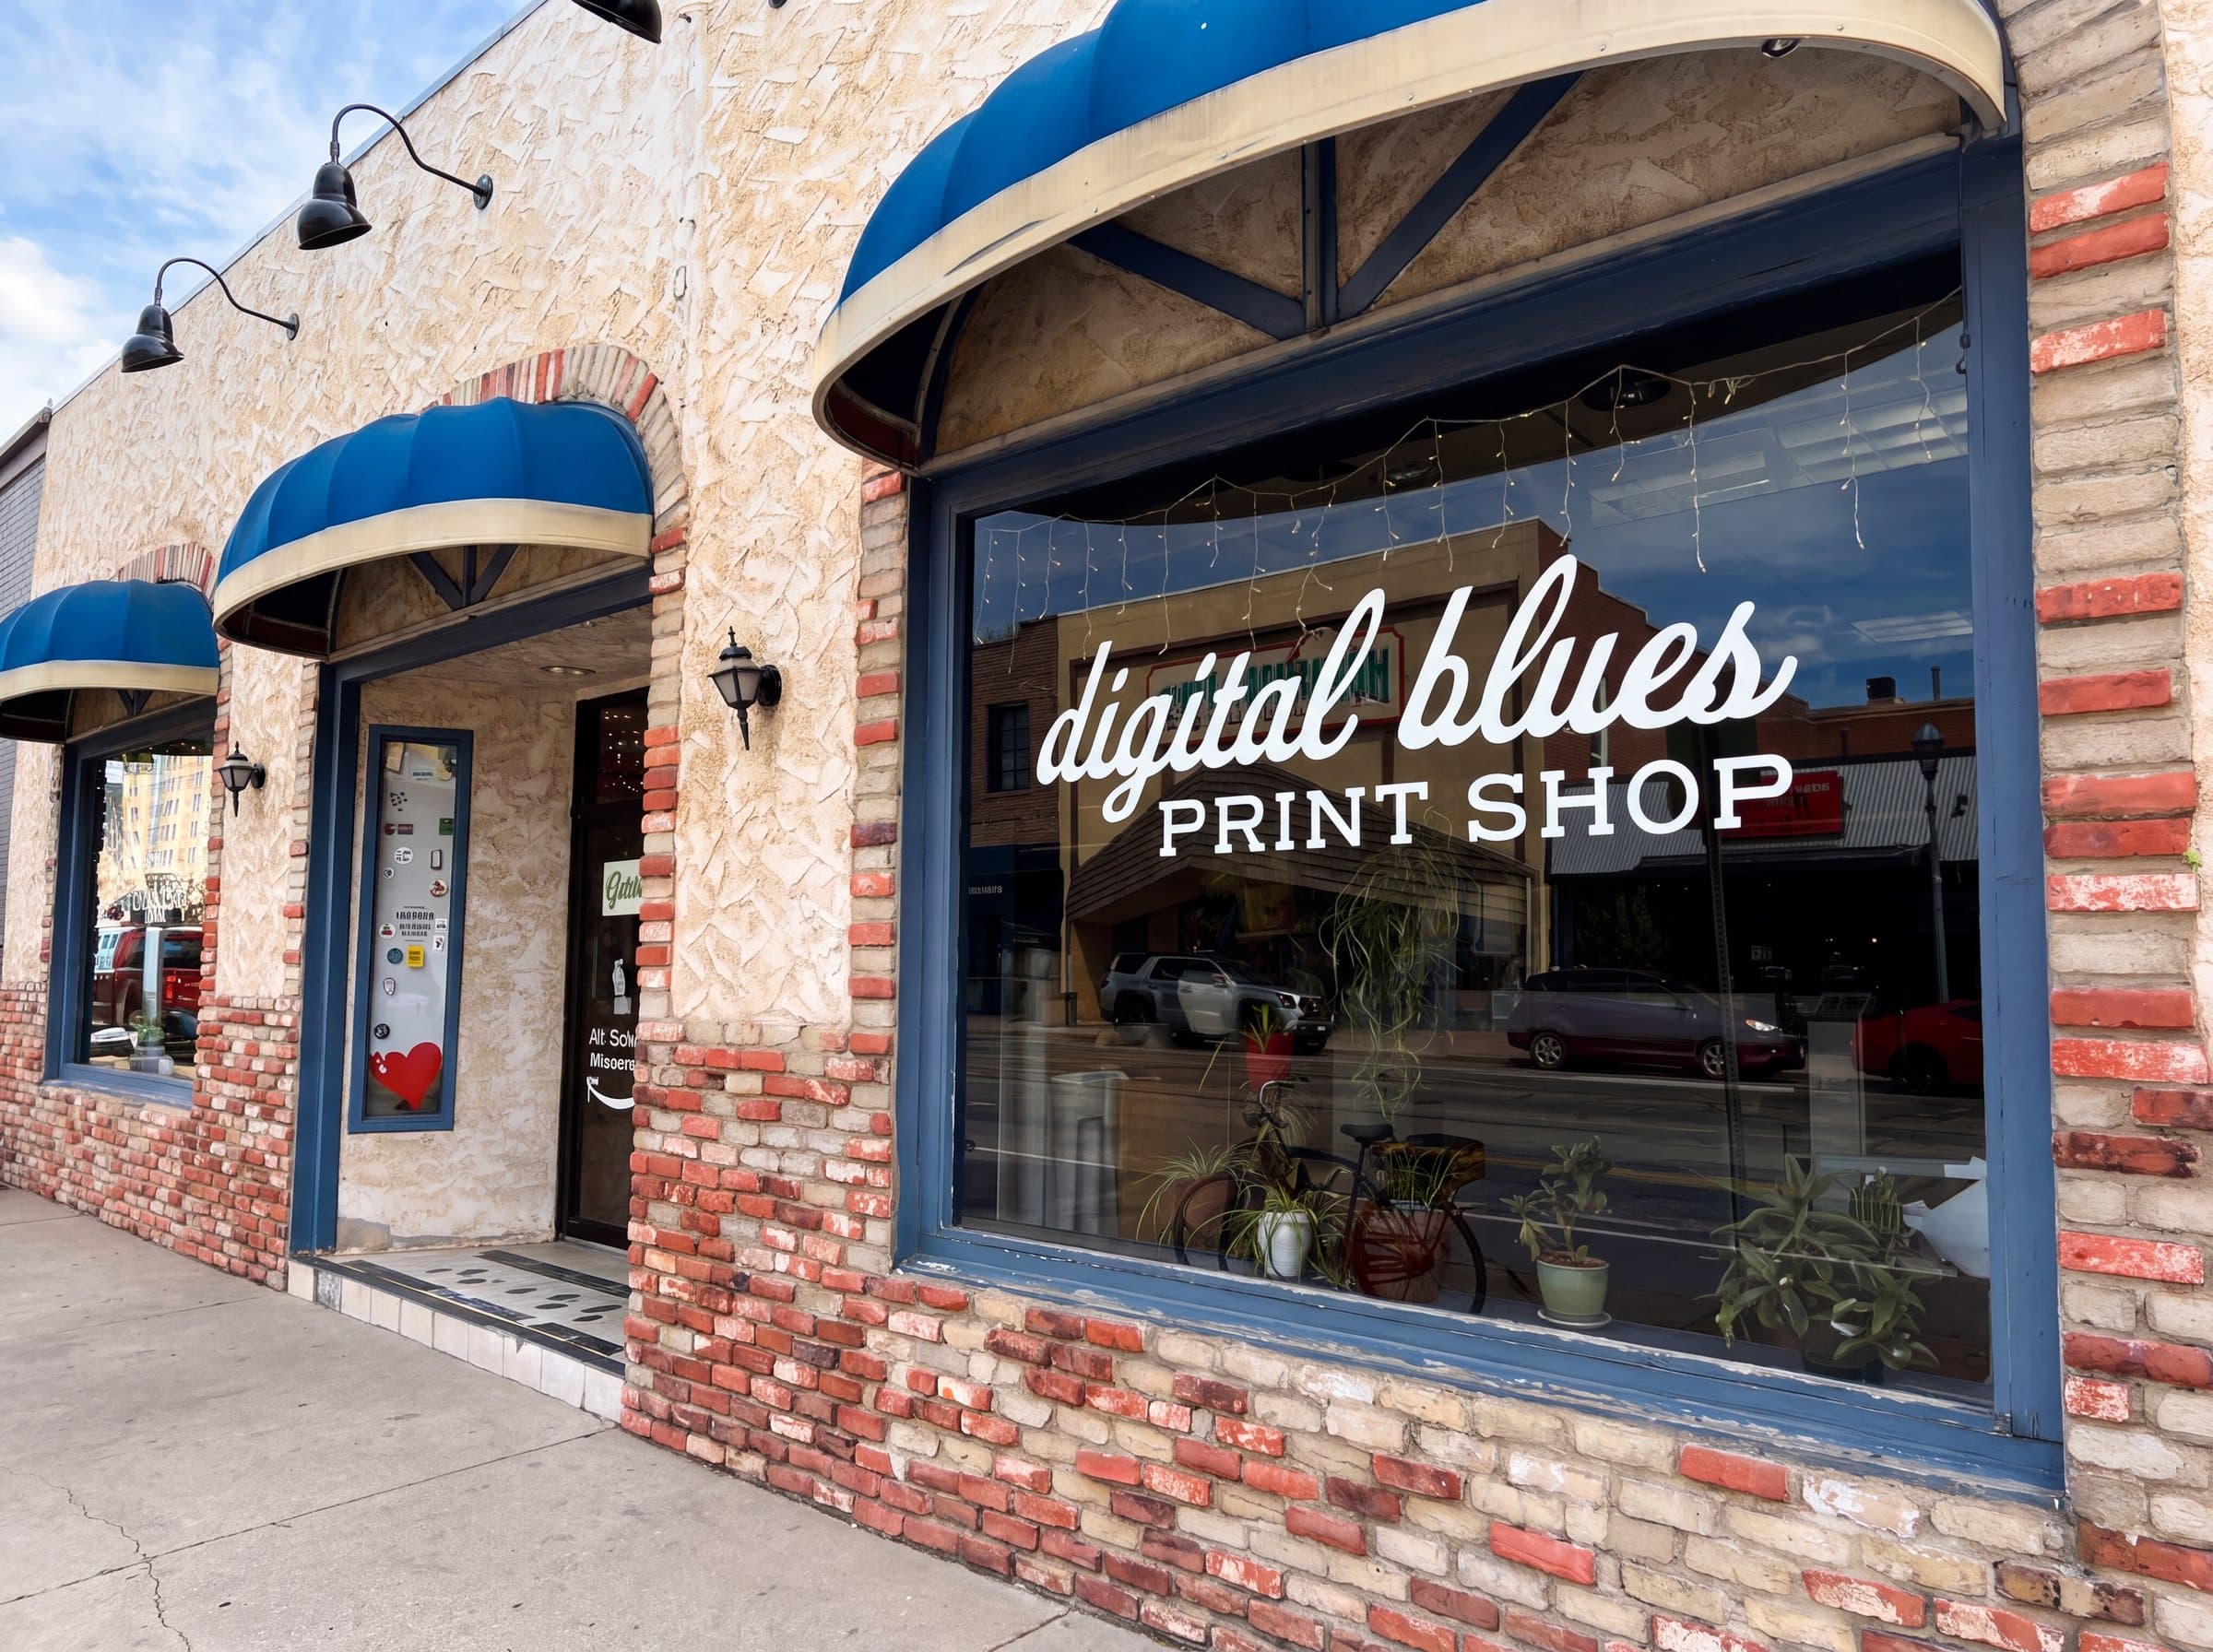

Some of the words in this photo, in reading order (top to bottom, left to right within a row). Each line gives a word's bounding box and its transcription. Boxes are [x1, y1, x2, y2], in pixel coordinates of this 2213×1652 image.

[1035, 587, 1386, 823] digital
[1397, 553, 1798, 751] blues
[1158, 786, 1429, 857] PRINT
[1467, 753, 1794, 843] SHOP
